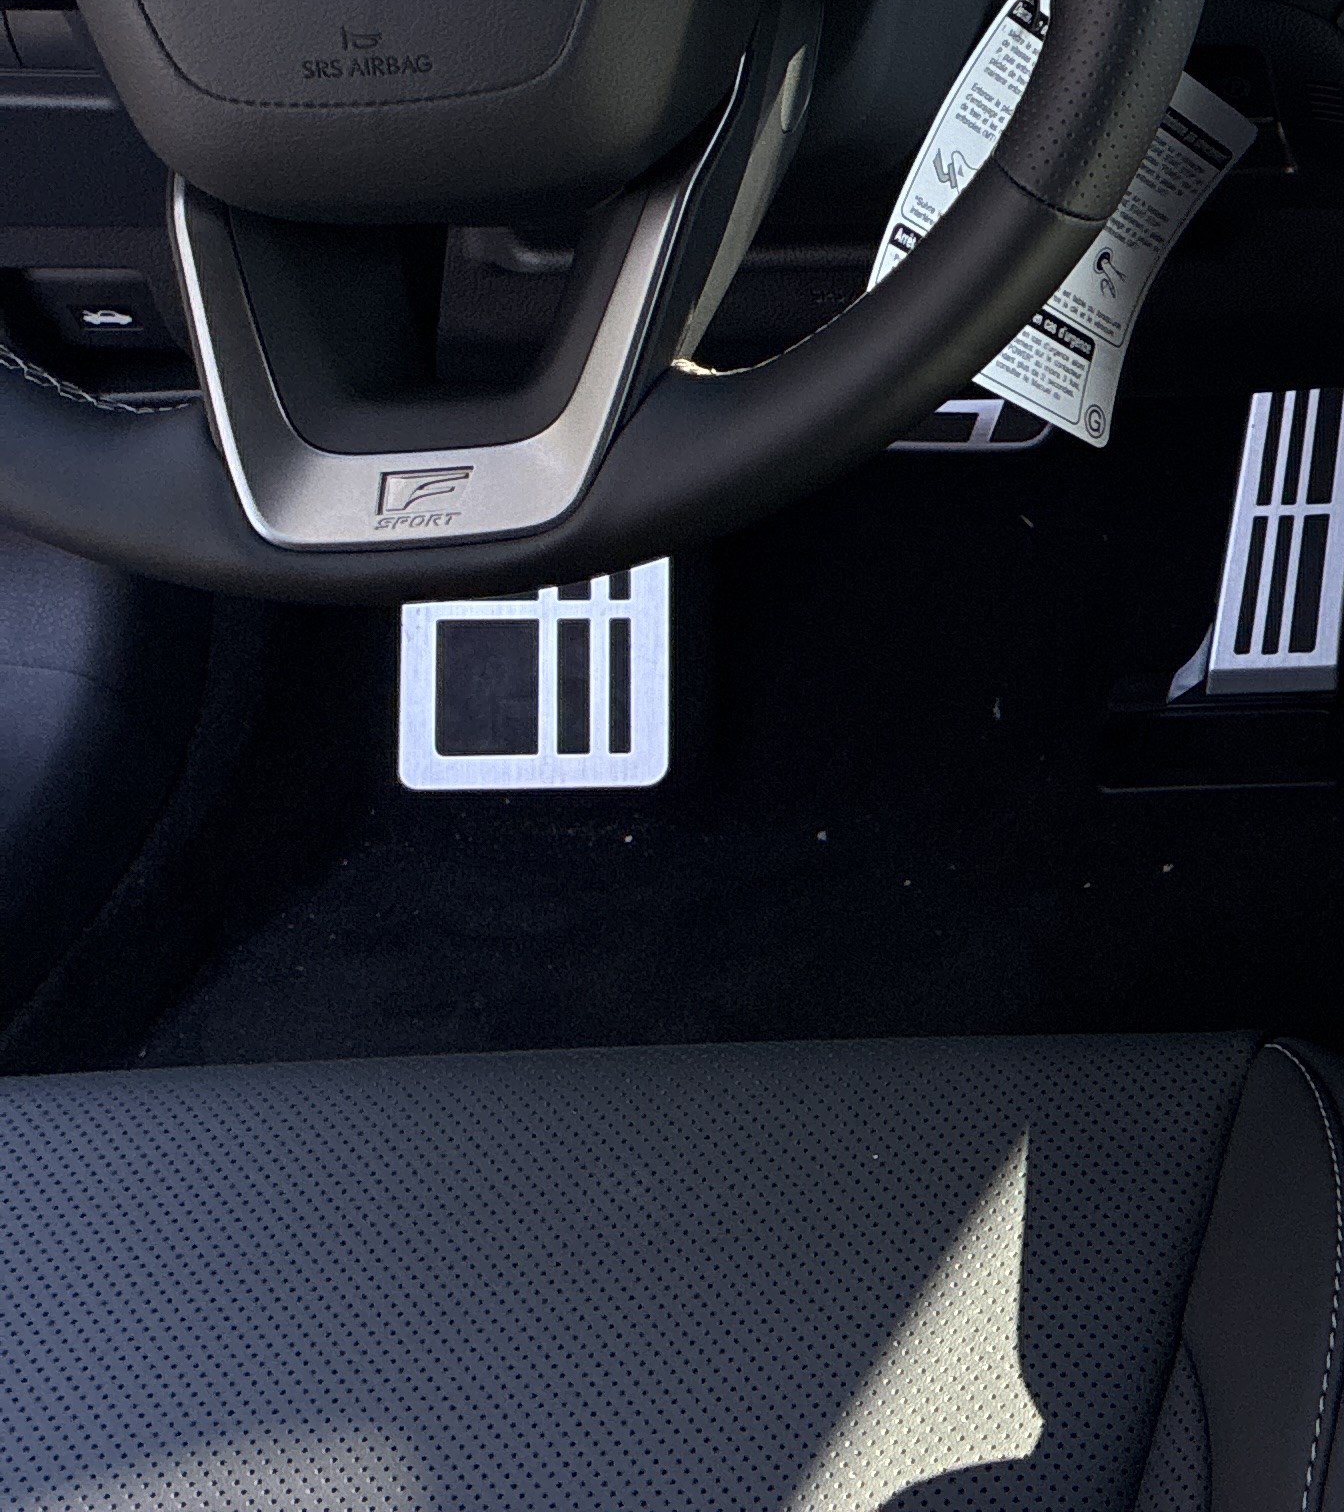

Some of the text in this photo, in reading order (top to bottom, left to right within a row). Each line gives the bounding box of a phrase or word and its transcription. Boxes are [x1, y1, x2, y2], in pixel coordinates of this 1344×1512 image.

[301, 53, 433, 79] SRS AIRBAG
[374, 511, 462, 531] SPORT
